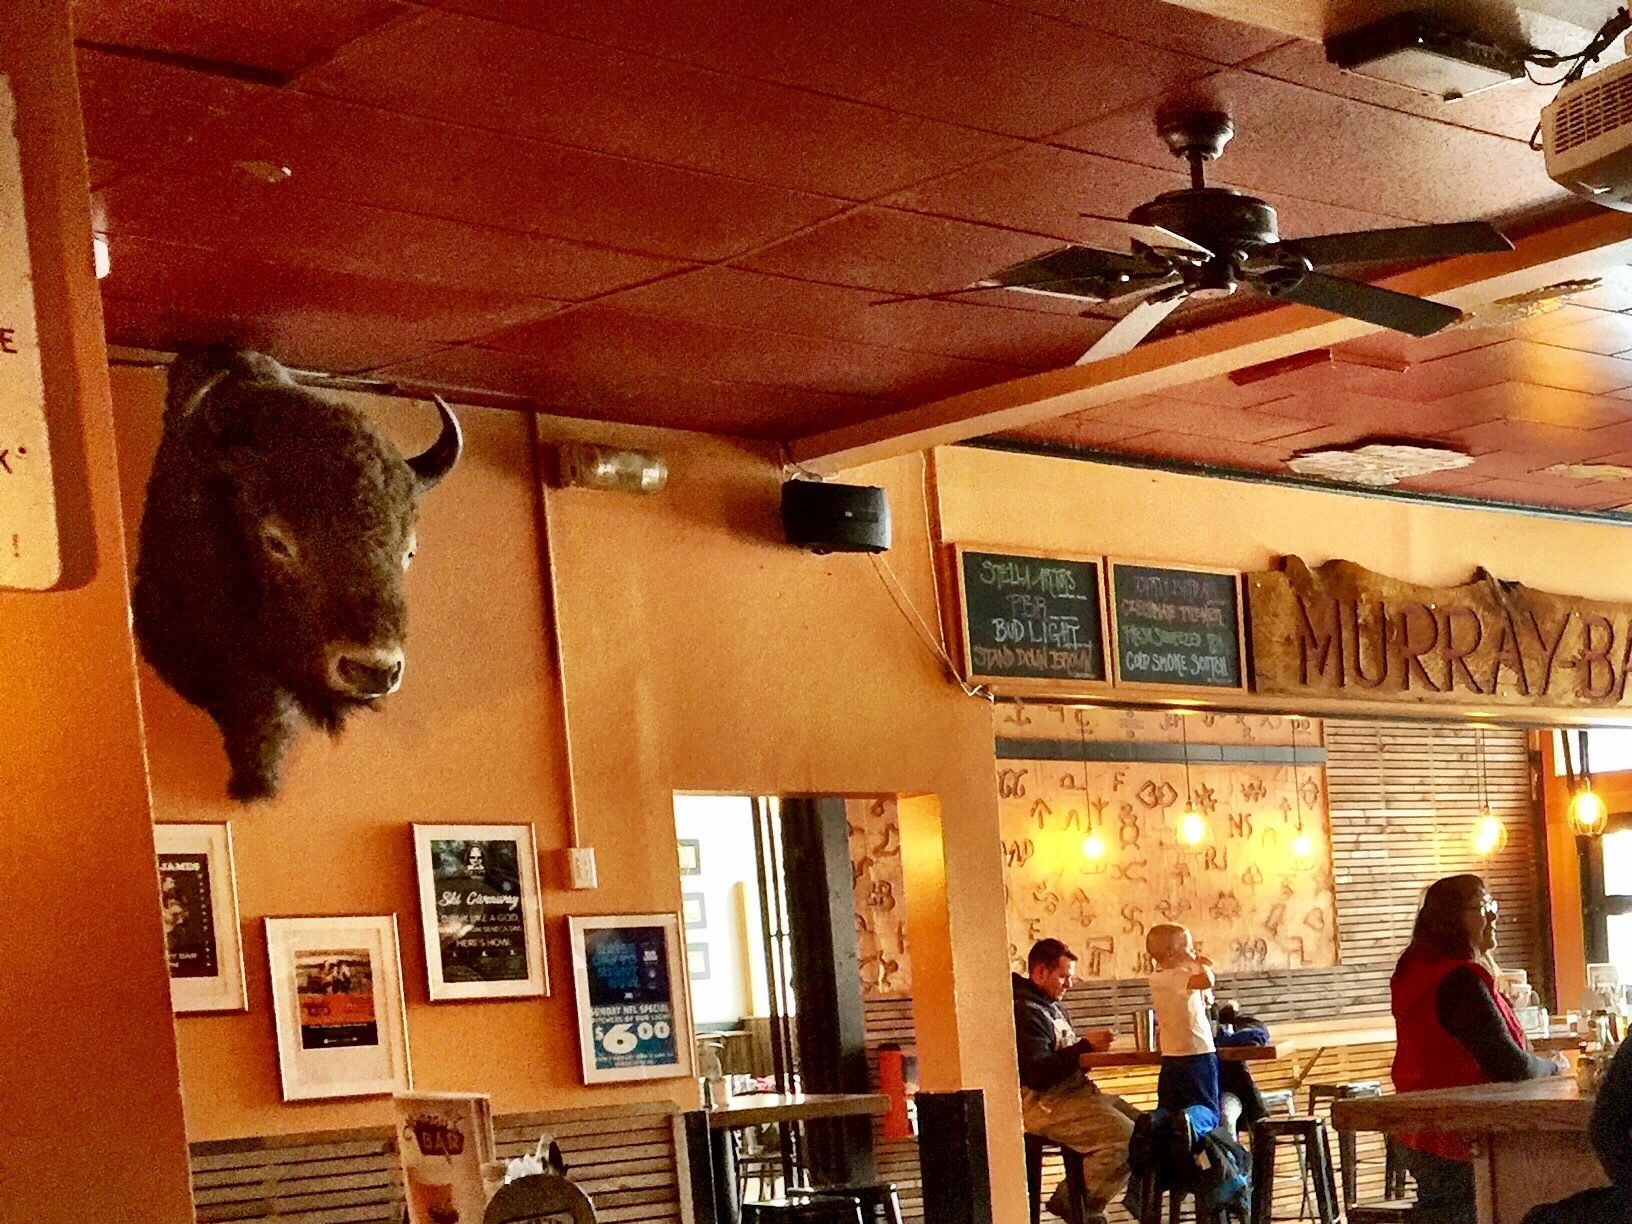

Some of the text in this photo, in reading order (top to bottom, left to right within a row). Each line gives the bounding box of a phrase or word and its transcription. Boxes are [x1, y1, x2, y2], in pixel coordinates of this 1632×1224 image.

[1005, 593, 1048, 620] PBR
[991, 617, 1081, 651] BUD LIGHT
[1297, 594, 1570, 696] MURRAY
[1151, 652, 1187, 677] SMOKE
